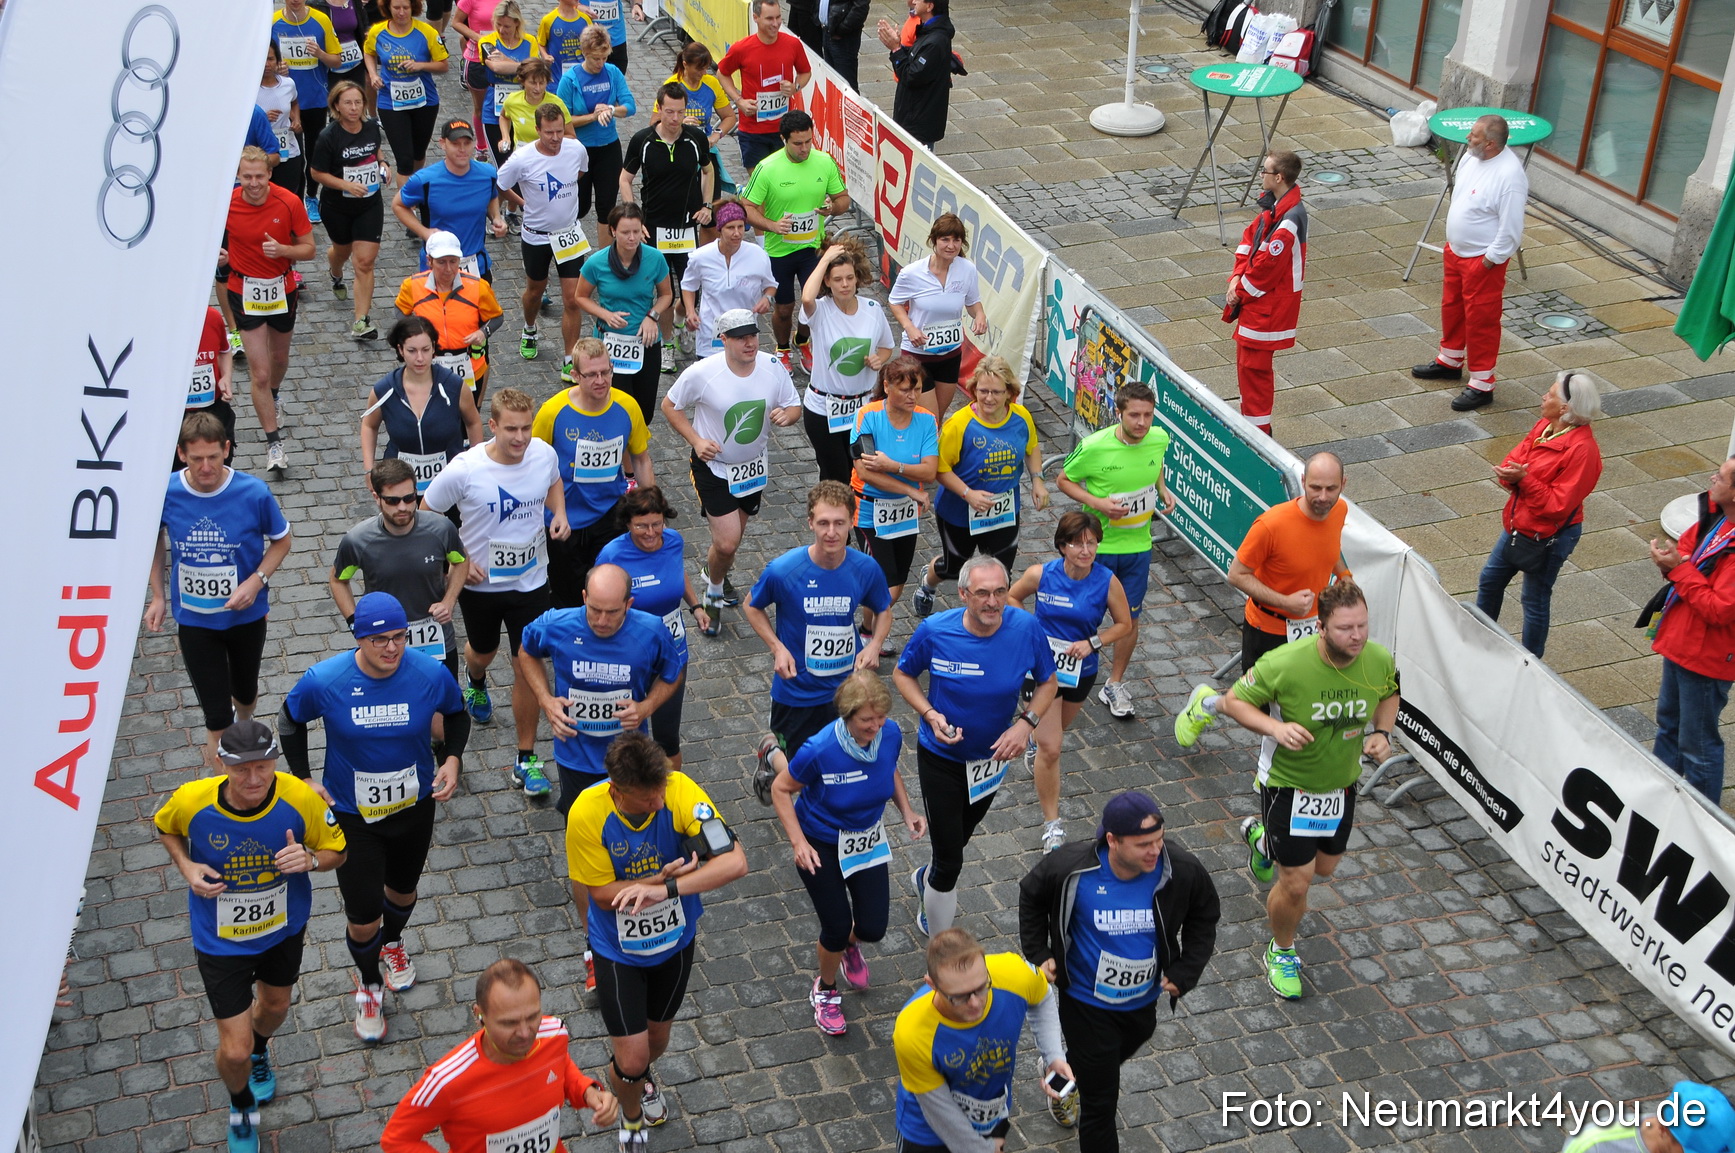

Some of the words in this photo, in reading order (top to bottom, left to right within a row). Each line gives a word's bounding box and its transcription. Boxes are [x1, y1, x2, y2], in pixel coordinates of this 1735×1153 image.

[395, 85, 423, 102] 2629
[760, 95, 787, 112] 2102
[664, 227, 686, 239] 307
[791, 219, 814, 234] 642
[557, 223, 580, 249] 636
[252, 286, 278, 302] 318
[927, 328, 961, 346] 2530
[1162, 391, 1231, 458] Event-Leit-Systeme
[69, 333, 134, 539] BKK
[577, 444, 594, 452] PARTL
[580, 449, 619, 468] 3321
[731, 459, 765, 482] 2286
[1172, 441, 1231, 508] Sicherheit
[739, 479, 759, 491] Michael
[1176, 471, 1213, 520] Event!
[507, 510, 533, 521] Team
[878, 504, 914, 524] 3416
[489, 542, 508, 551] PARTL
[1185, 518, 1203, 544] Line:
[1203, 537, 1226, 570] 09181
[494, 546, 536, 567] 3310
[199, 569, 226, 578] Neumarkt
[184, 577, 232, 598] 3393
[803, 596, 851, 609] HUBER
[811, 636, 854, 658] 2926
[572, 660, 631, 677] HUBER
[814, 659, 849, 670] Sebastian
[34, 585, 112, 811] Audi
[570, 693, 590, 702] PARTL
[1320, 689, 1359, 701] FÜRTH
[351, 703, 410, 719] HUBER
[1311, 699, 1368, 721] 2012
[364, 715, 408, 723] TECHNOLOGY
[582, 720, 619, 731] Willibald
[356, 776, 378, 784] PARTL
[379, 774, 408, 784] Neumarkt
[1443, 750, 1460, 770] die
[1460, 765, 1508, 821] verbinden
[368, 782, 406, 805] 311
[368, 802, 407, 816] Johannes
[1298, 795, 1341, 817] 2320
[1308, 820, 1329, 831] Mirza
[218, 896, 244, 905] PARTL
[245, 893, 278, 904] Neumarkt
[232, 900, 276, 924] 284
[639, 903, 673, 917] Neumarkt
[1540, 839, 1687, 988] stadtwerke
[232, 920, 275, 936] Karlheinz
[623, 908, 681, 939] 2654
[641, 935, 668, 950] Oliver
[1101, 956, 1125, 968] PARTL
[1103, 963, 1156, 987] 2860
[488, 1134, 516, 1146] PARTL
[517, 1120, 552, 1140] Neumarkt
